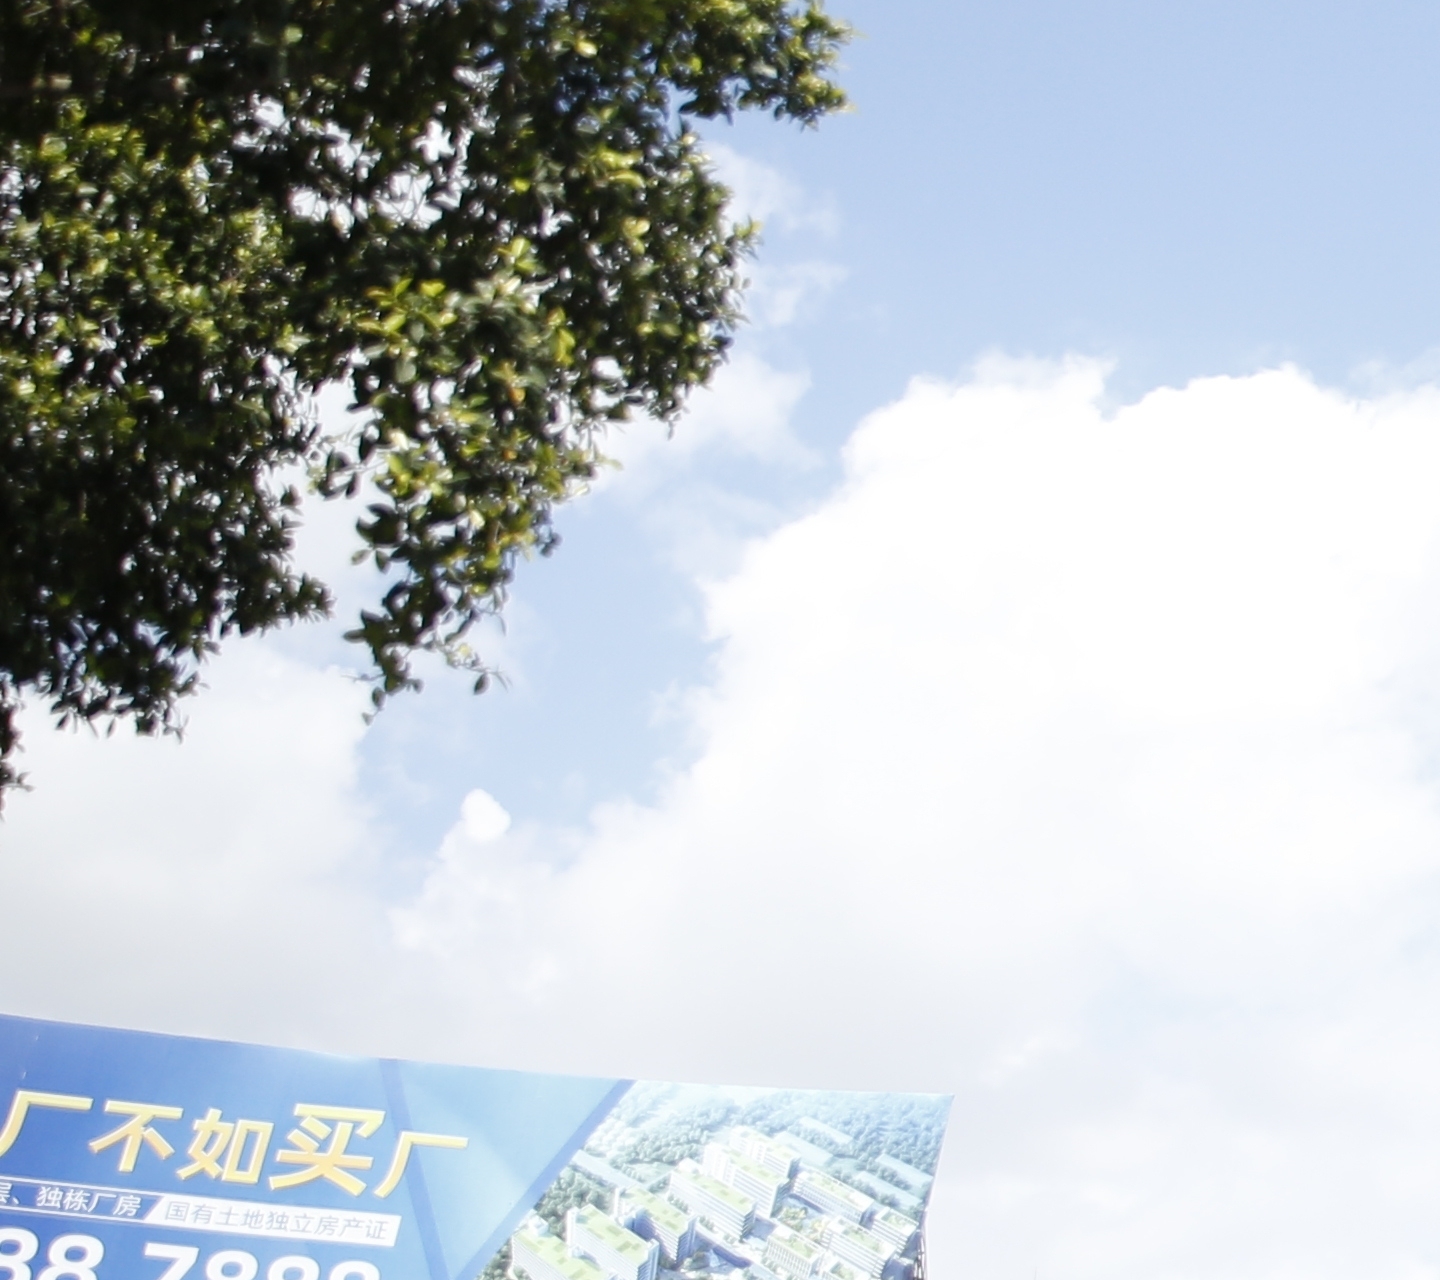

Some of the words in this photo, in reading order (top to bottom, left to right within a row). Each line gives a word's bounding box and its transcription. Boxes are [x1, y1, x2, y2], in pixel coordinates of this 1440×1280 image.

[0, 1090, 469, 1199] 厂不如买厂
[164, 1199, 390, 1241] 国有土地独立房产证
